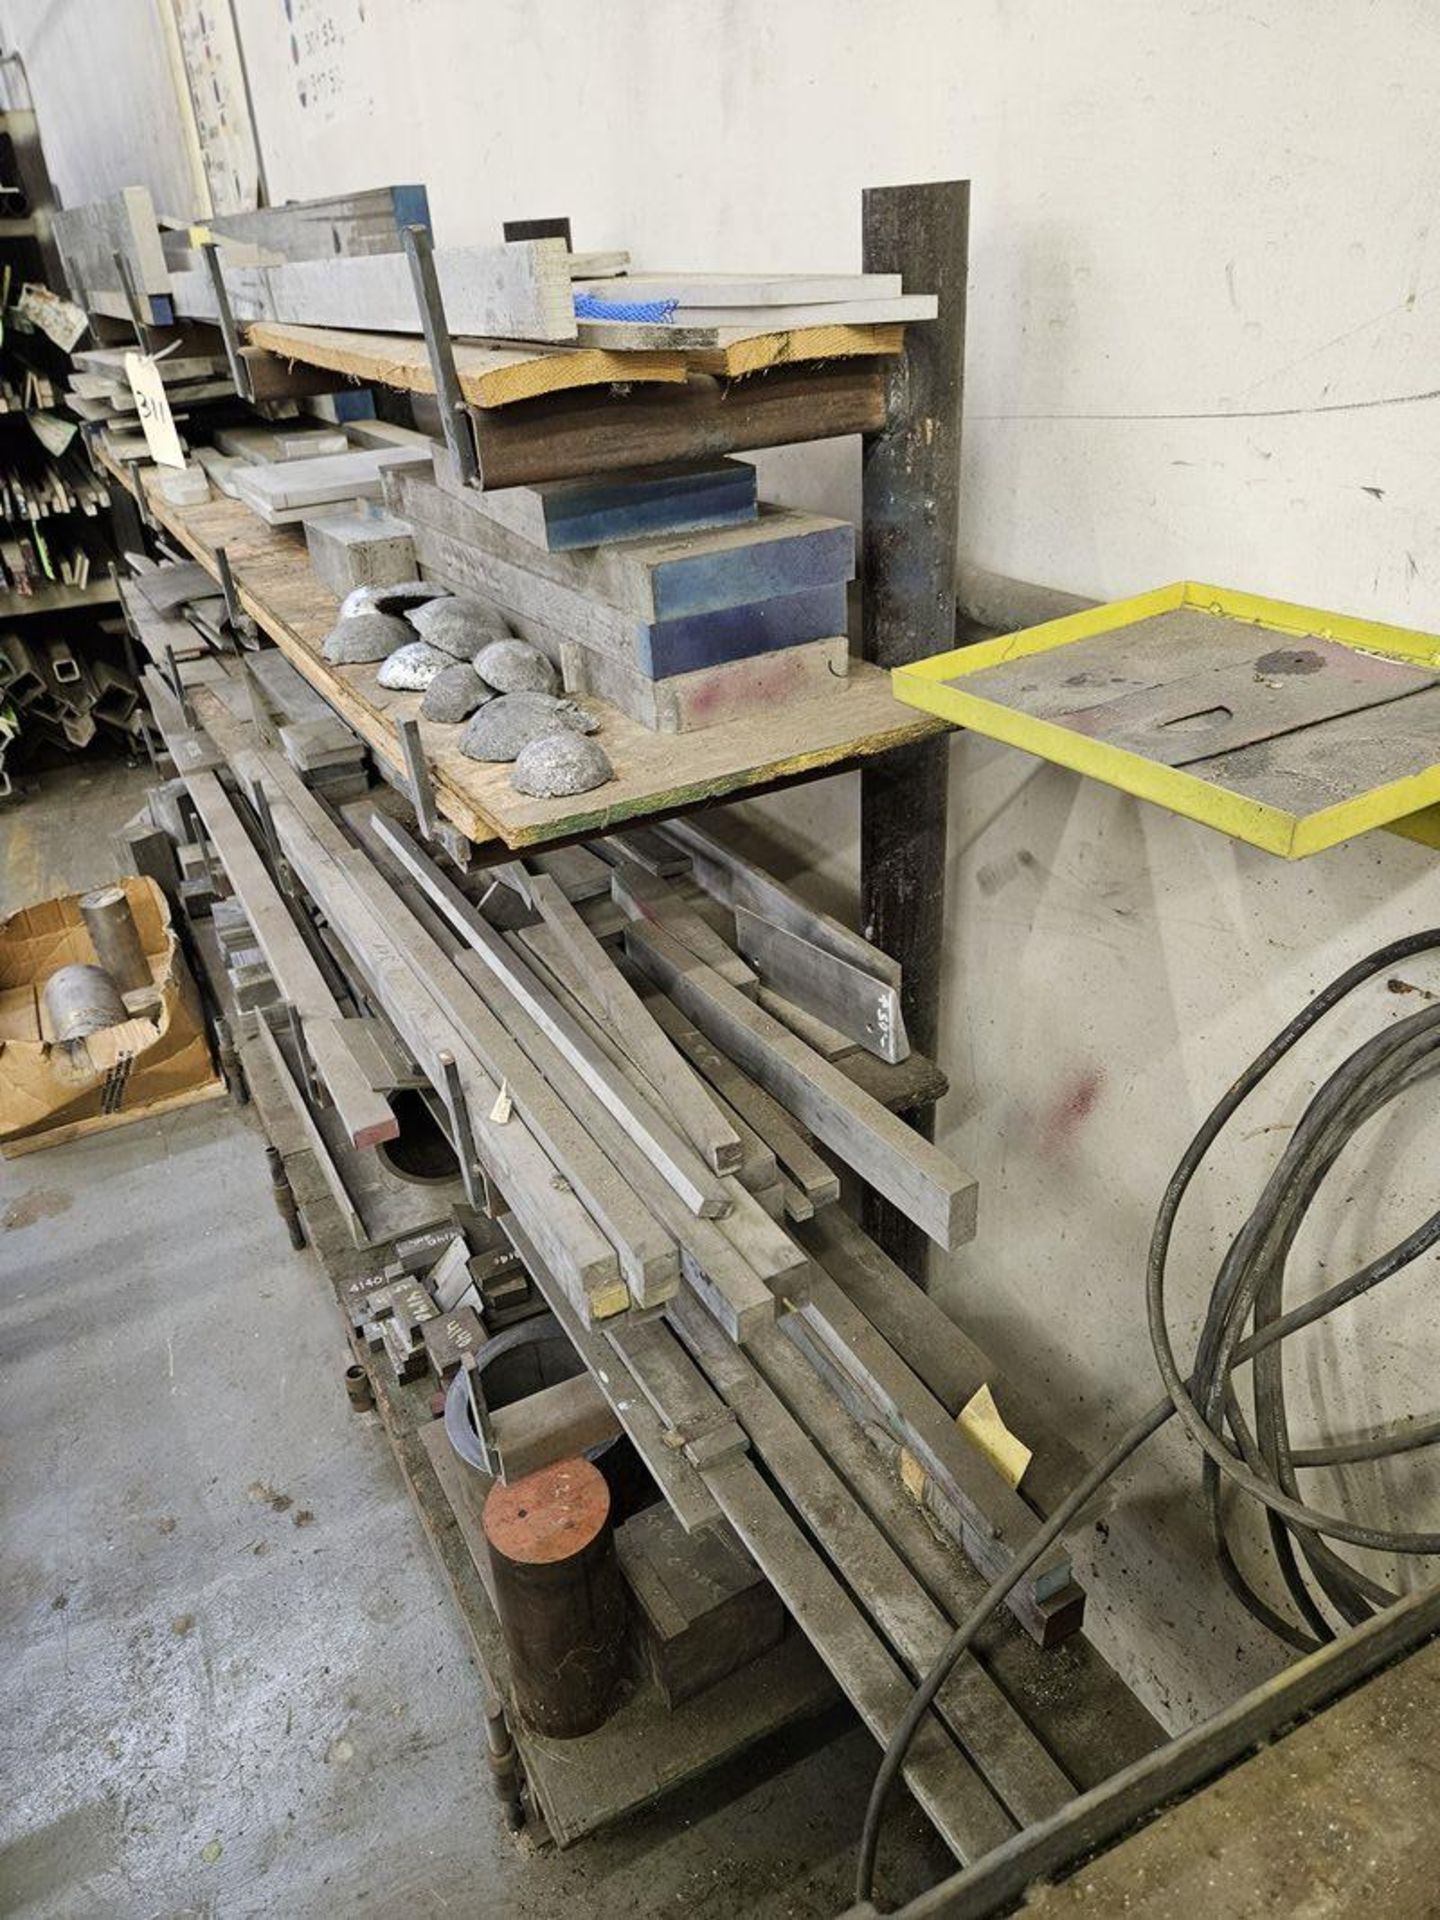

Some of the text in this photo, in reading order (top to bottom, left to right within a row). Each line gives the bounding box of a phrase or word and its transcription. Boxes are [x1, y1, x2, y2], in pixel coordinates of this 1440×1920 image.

[136, 390, 166, 424] 311
[350, 1276, 383, 1293] 4140
[406, 1291, 433, 1321] 4140
[447, 1319, 473, 1348] 4140
